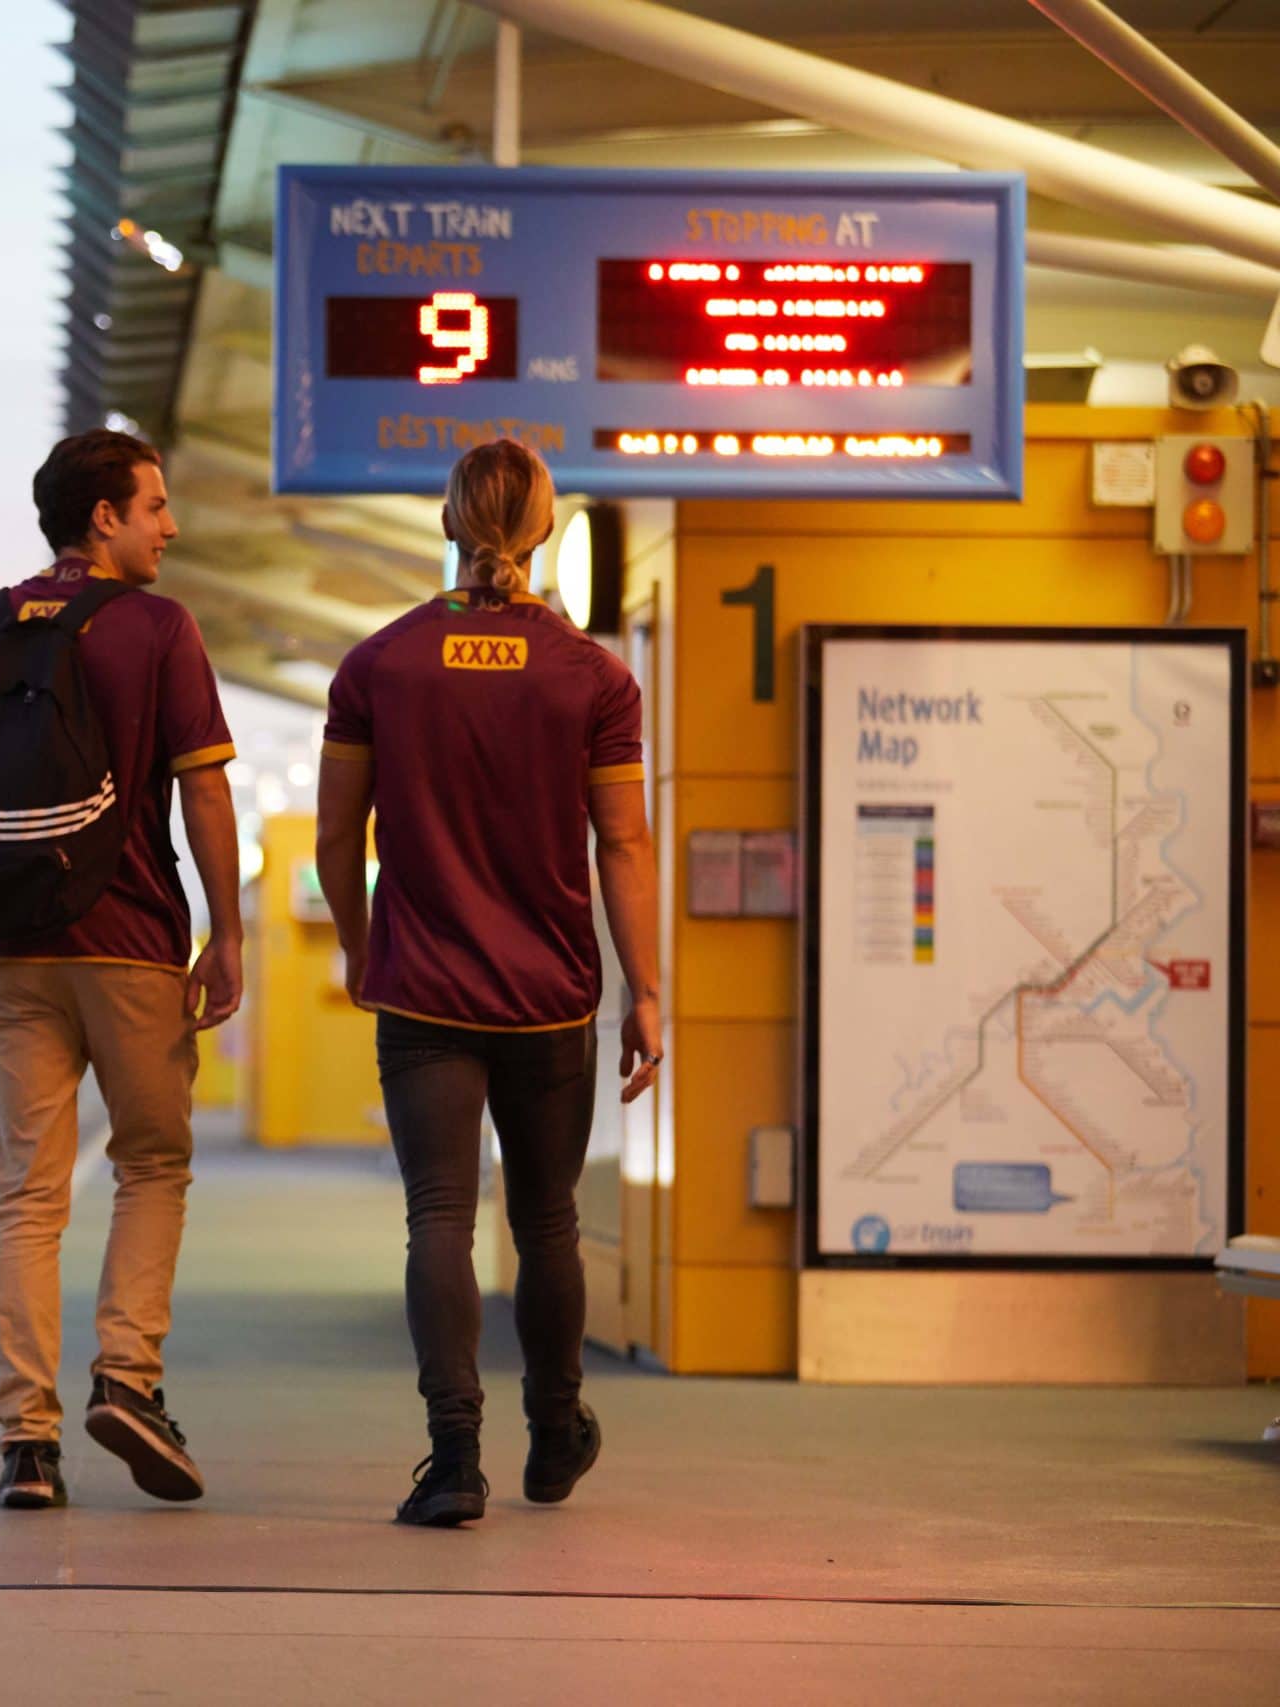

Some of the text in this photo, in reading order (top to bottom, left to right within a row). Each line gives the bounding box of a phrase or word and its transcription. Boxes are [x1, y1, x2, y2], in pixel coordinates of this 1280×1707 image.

[330, 201, 512, 239] NEXT TRAIN
[686, 208, 880, 248] STOPPING AT
[356, 240, 483, 278] DEPARTS
[419, 292, 488, 384] 9
[720, 563, 776, 703] 1
[448, 640, 521, 666] XXXX
[856, 688, 983, 725] Network
[856, 729, 919, 768] Map
